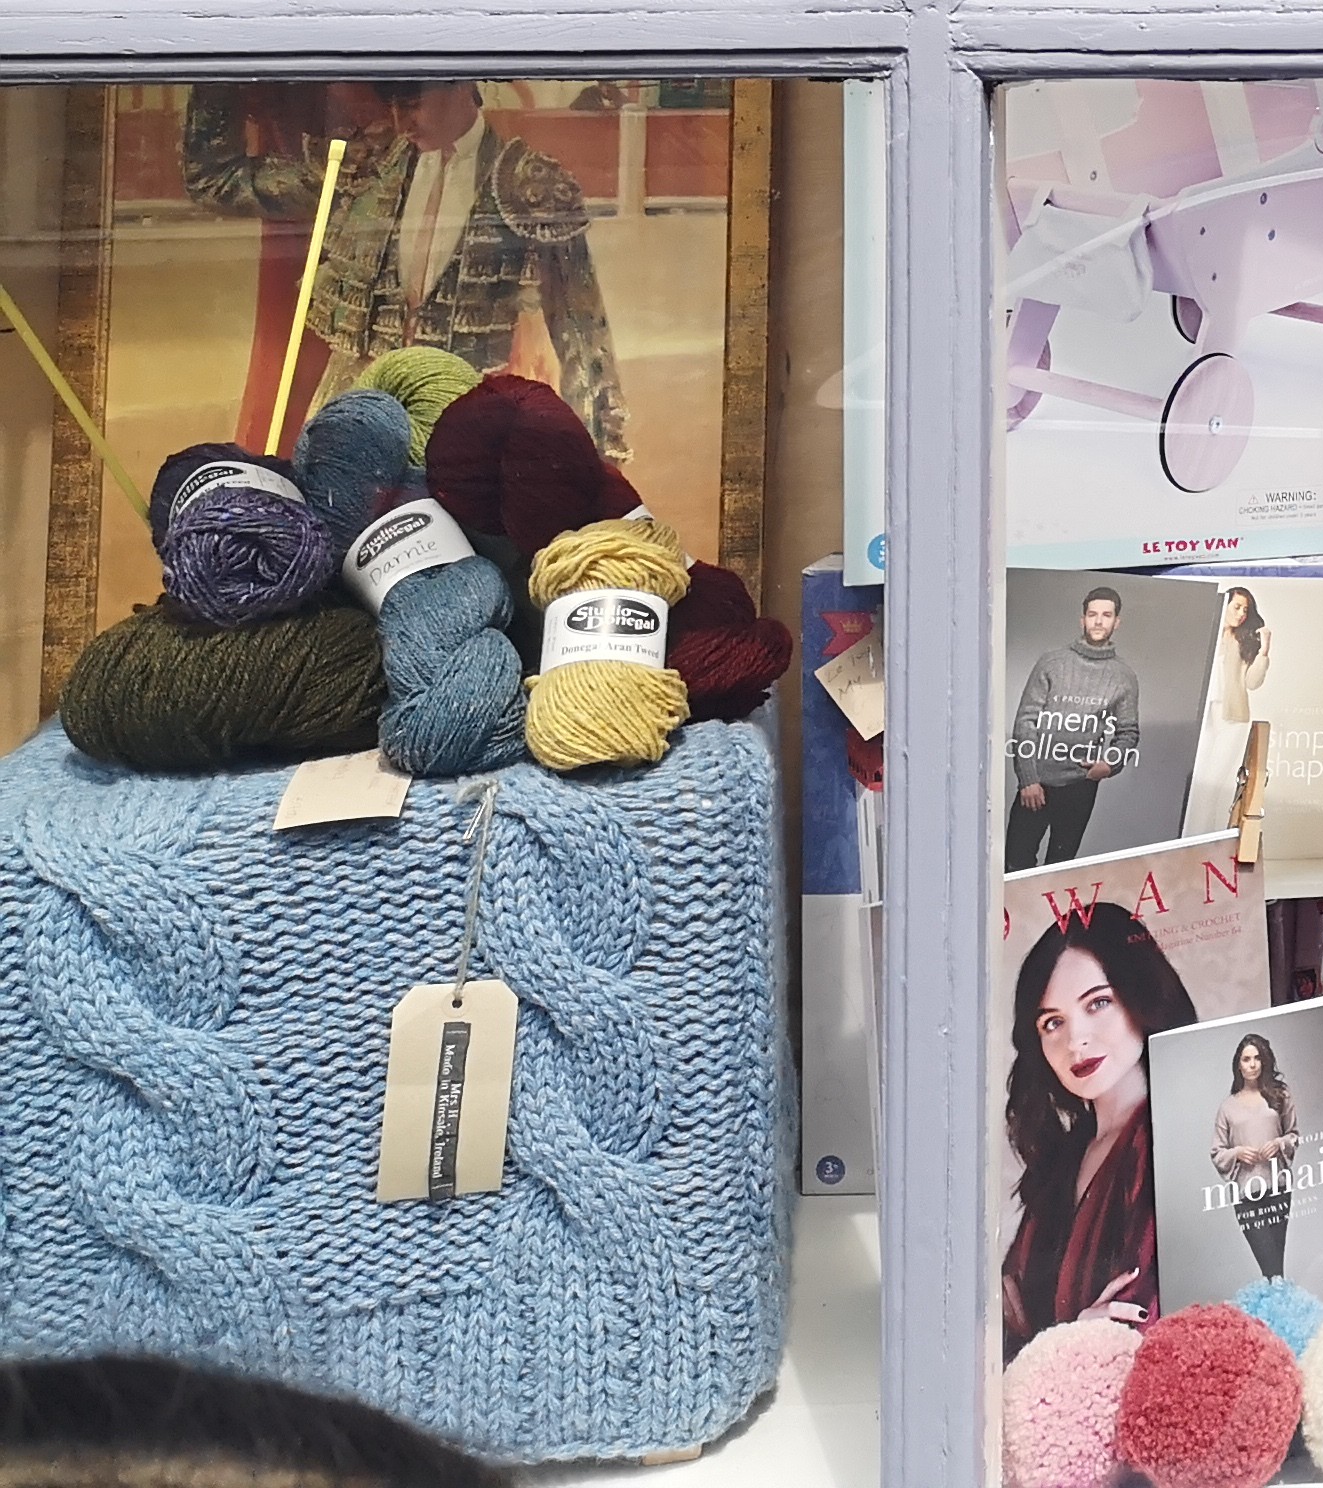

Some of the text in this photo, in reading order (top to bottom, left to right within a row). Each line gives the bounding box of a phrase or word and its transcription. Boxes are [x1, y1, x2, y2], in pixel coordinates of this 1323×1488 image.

[1265, 491, 1317, 503] WARNING:
[360, 517, 414, 561] Studio
[369, 518, 425, 557] Donegal
[1143, 537, 1240, 554] LE TOY VAN
[369, 540, 437, 586] Darnie
[584, 616, 655, 631] Donegal
[561, 642, 660, 659] Donega Aran Tweed
[1062, 695, 1109, 707] PROJECTS
[1036, 710, 1118, 735] men's
[1004, 734, 1141, 767] collection
[1191, 912, 1241, 930] CROCHET
[1195, 930, 1229, 945] Number
[442, 1043, 456, 1075] Made
[450, 1082, 462, 1106] Mrs
[434, 1095, 448, 1139] Kinsale,
[432, 1142, 446, 1179] Ireland
[1258, 1200, 1289, 1216] ROWAN
